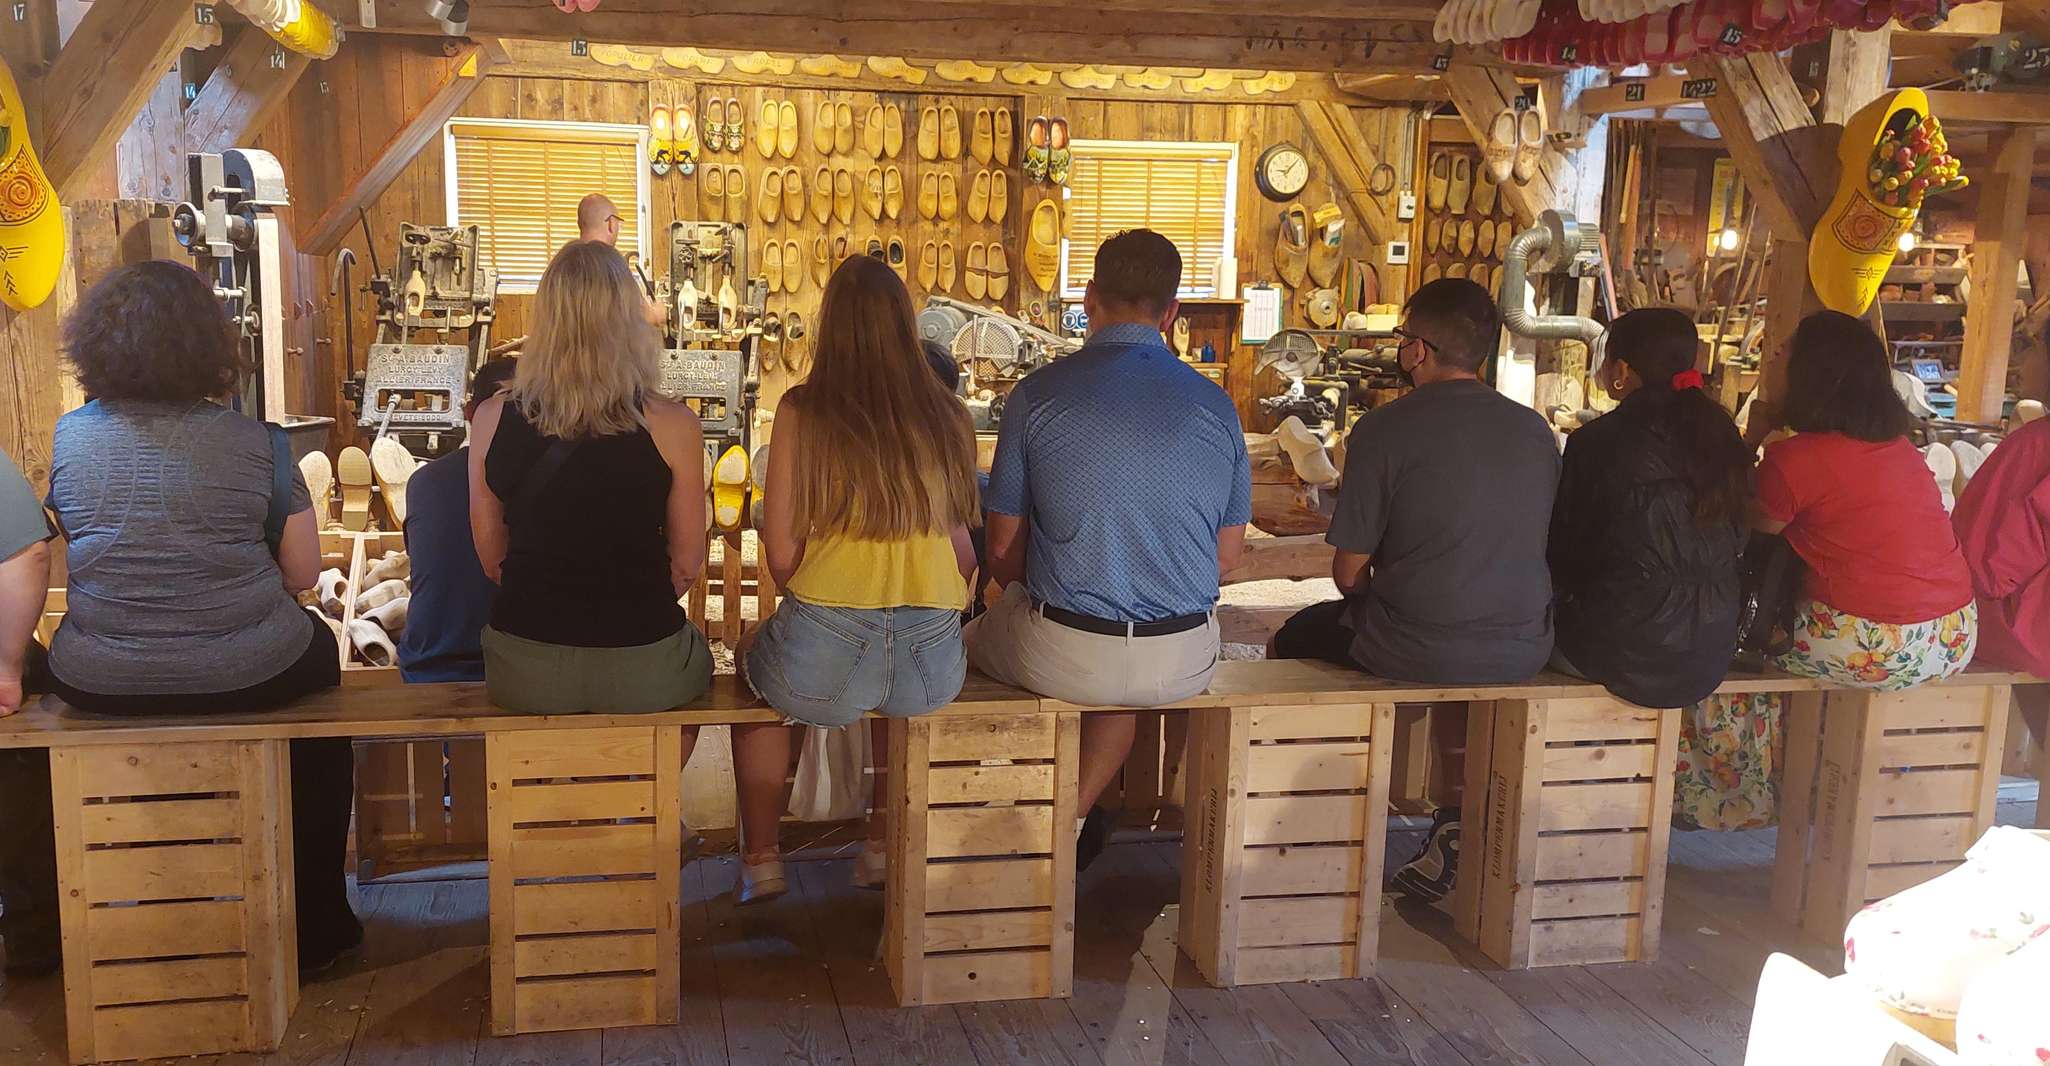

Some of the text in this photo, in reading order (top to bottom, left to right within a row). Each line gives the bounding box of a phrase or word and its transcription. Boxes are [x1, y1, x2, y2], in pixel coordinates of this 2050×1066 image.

[13, 4, 25, 21] 17
[1722, 27, 1742, 45] 15
[1627, 85, 1643, 100] 21
